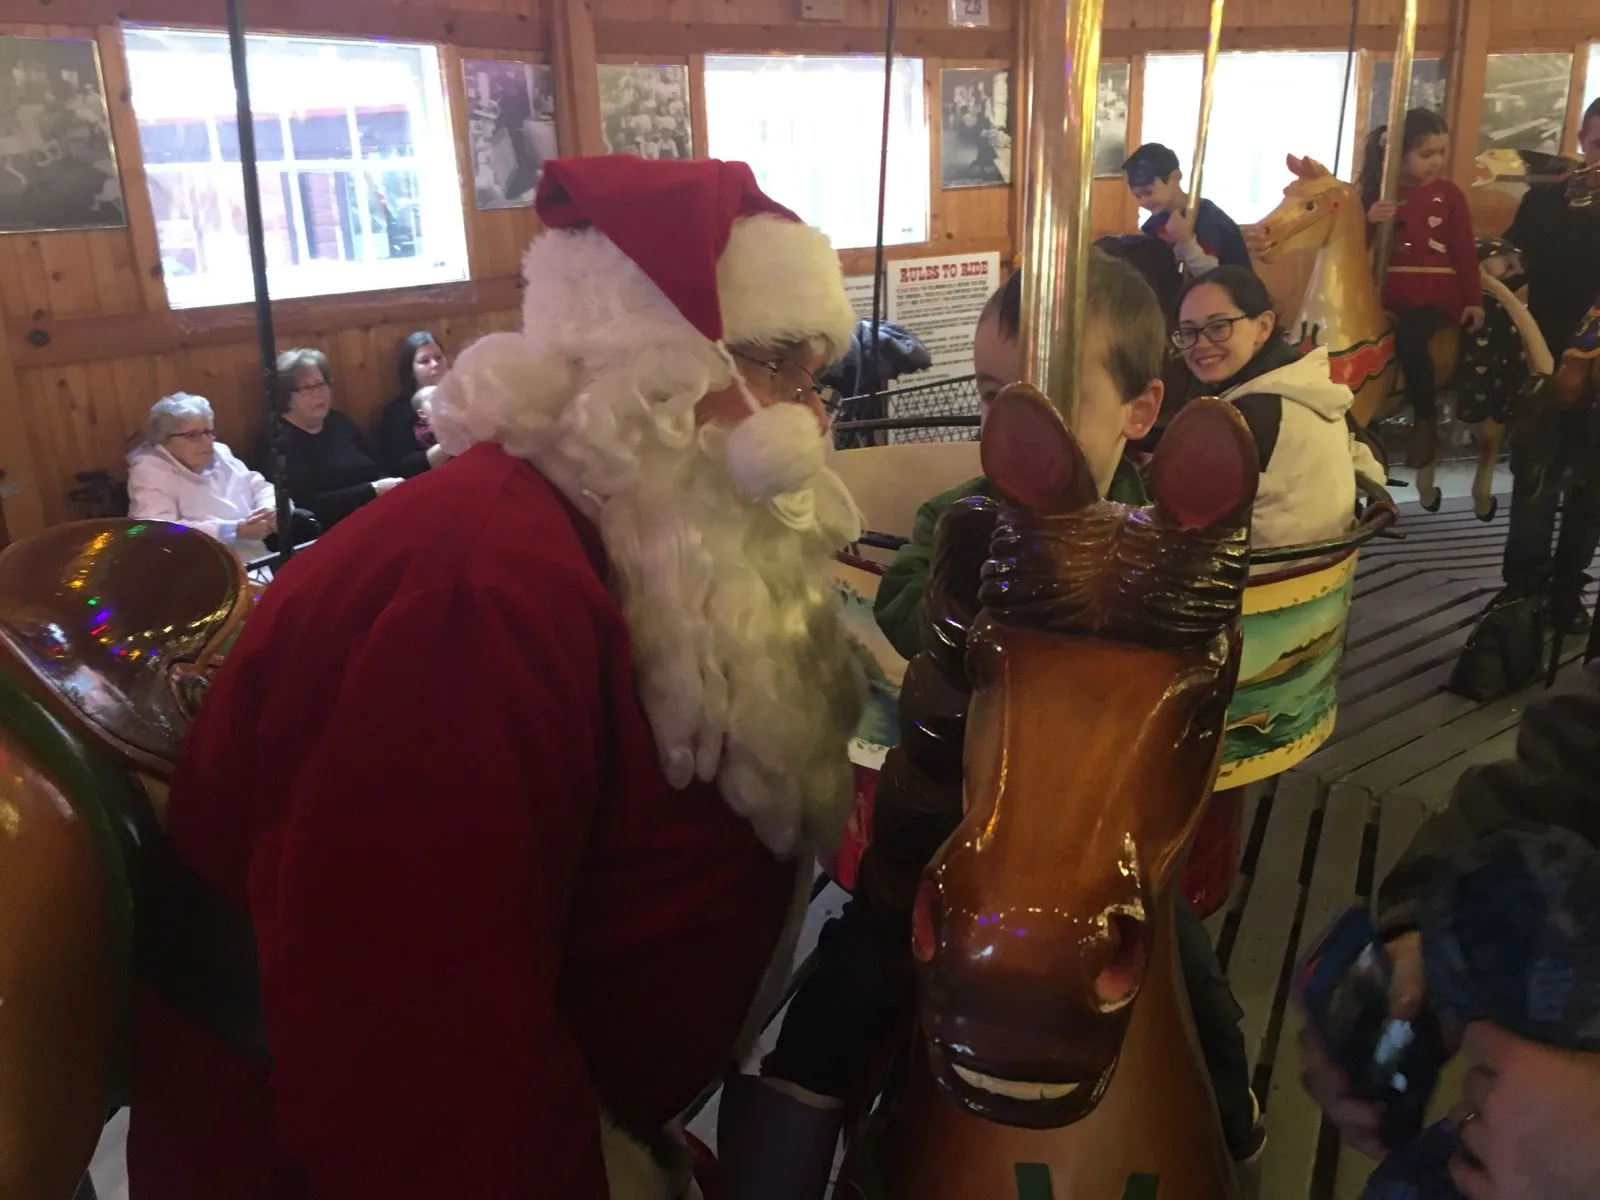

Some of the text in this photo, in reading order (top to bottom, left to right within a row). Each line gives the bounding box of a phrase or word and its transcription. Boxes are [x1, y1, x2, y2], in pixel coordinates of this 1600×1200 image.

[900, 261, 988, 283] RULES TO RIDE
